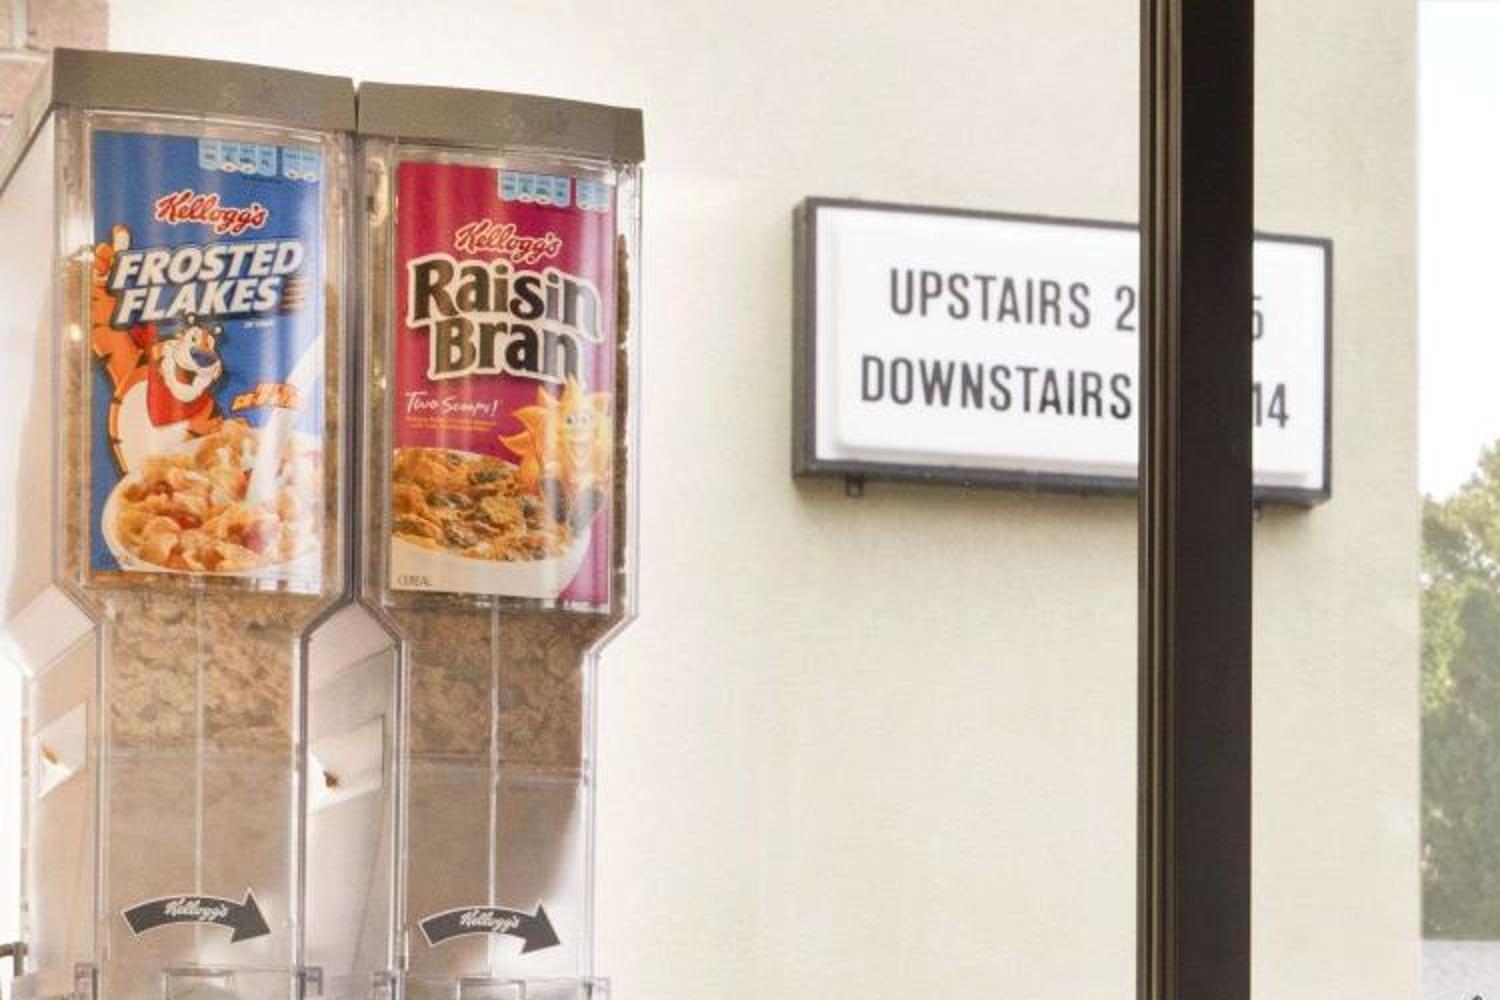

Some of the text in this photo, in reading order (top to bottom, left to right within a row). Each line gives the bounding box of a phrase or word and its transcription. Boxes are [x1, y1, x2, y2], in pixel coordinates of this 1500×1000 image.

[155, 189, 268, 235] Kellogg's
[455, 218, 562, 264] Kellogg's
[111, 241, 304, 289] FROSTED
[115, 277, 281, 323] FLAKES
[408, 255, 603, 342] Raisin
[890, 268, 1091, 329] UPSTAIRS
[430, 317, 584, 383] Bran
[405, 391, 439, 413] Two
[861, 354, 1133, 420] DOWNSTAIRS
[163, 897, 229, 922] Kellogg's
[459, 909, 520, 933] Kellogg's
